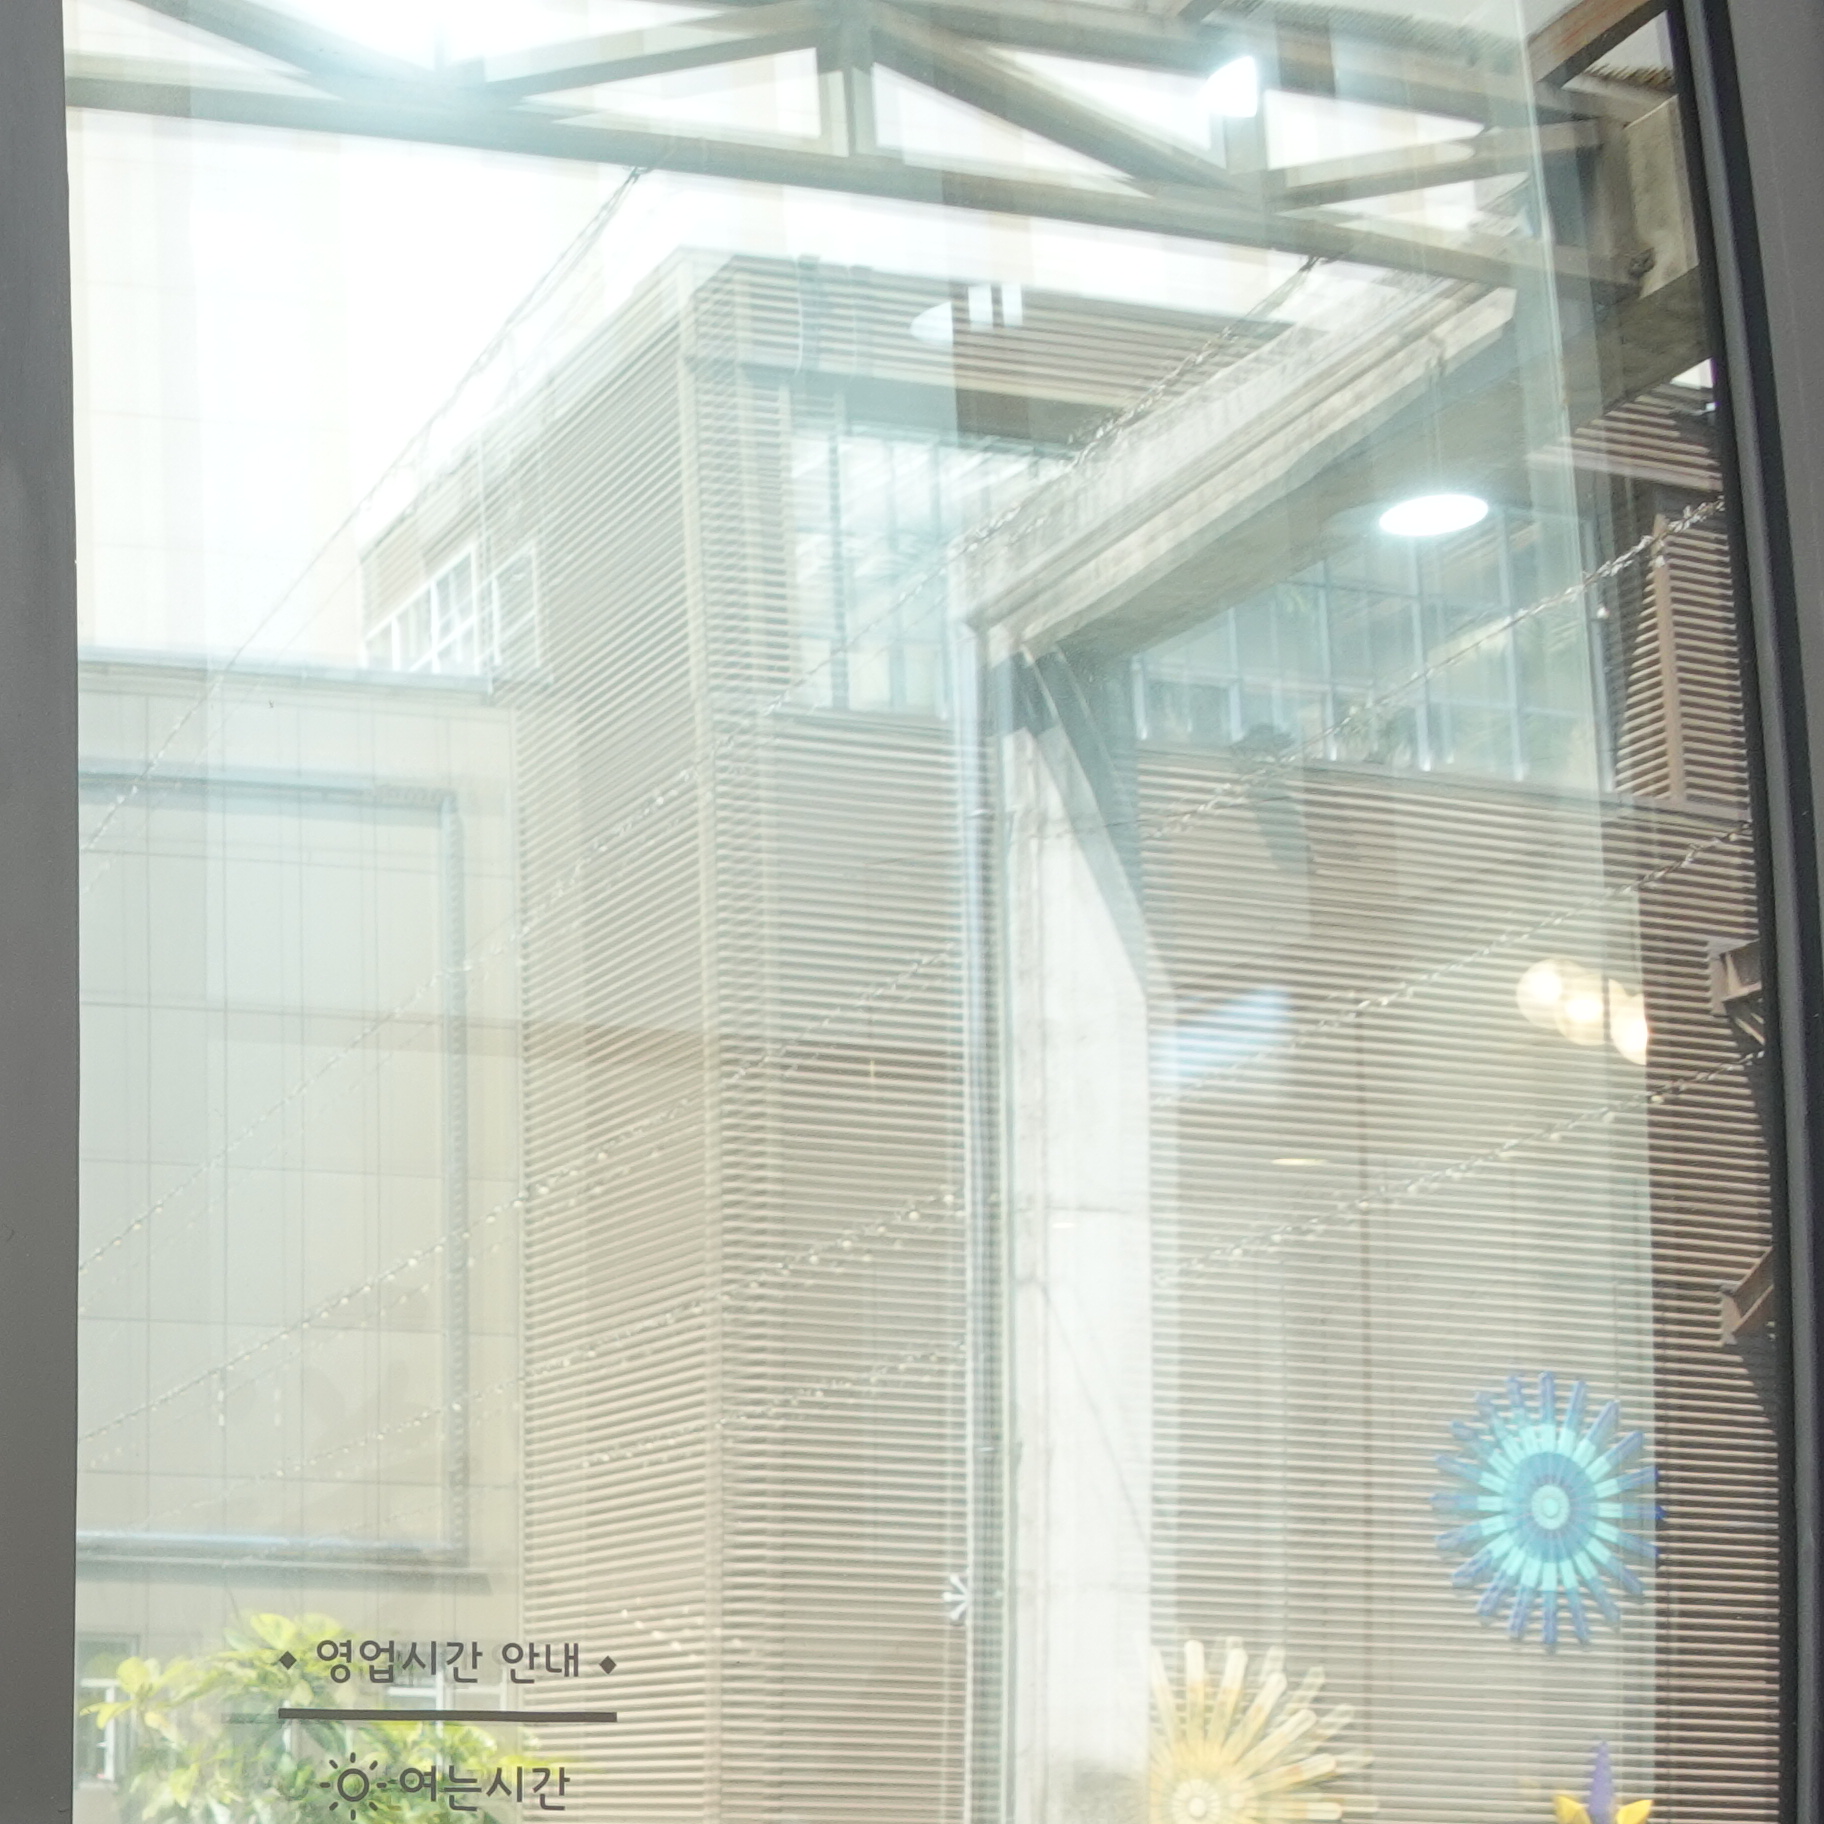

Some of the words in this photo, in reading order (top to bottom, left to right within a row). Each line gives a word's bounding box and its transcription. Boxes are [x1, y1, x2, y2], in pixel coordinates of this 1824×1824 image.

[316, 1639, 483, 1684] 영업시간
[502, 1641, 579, 1684] 안내
[399, 1765, 570, 1811] 여는시간
